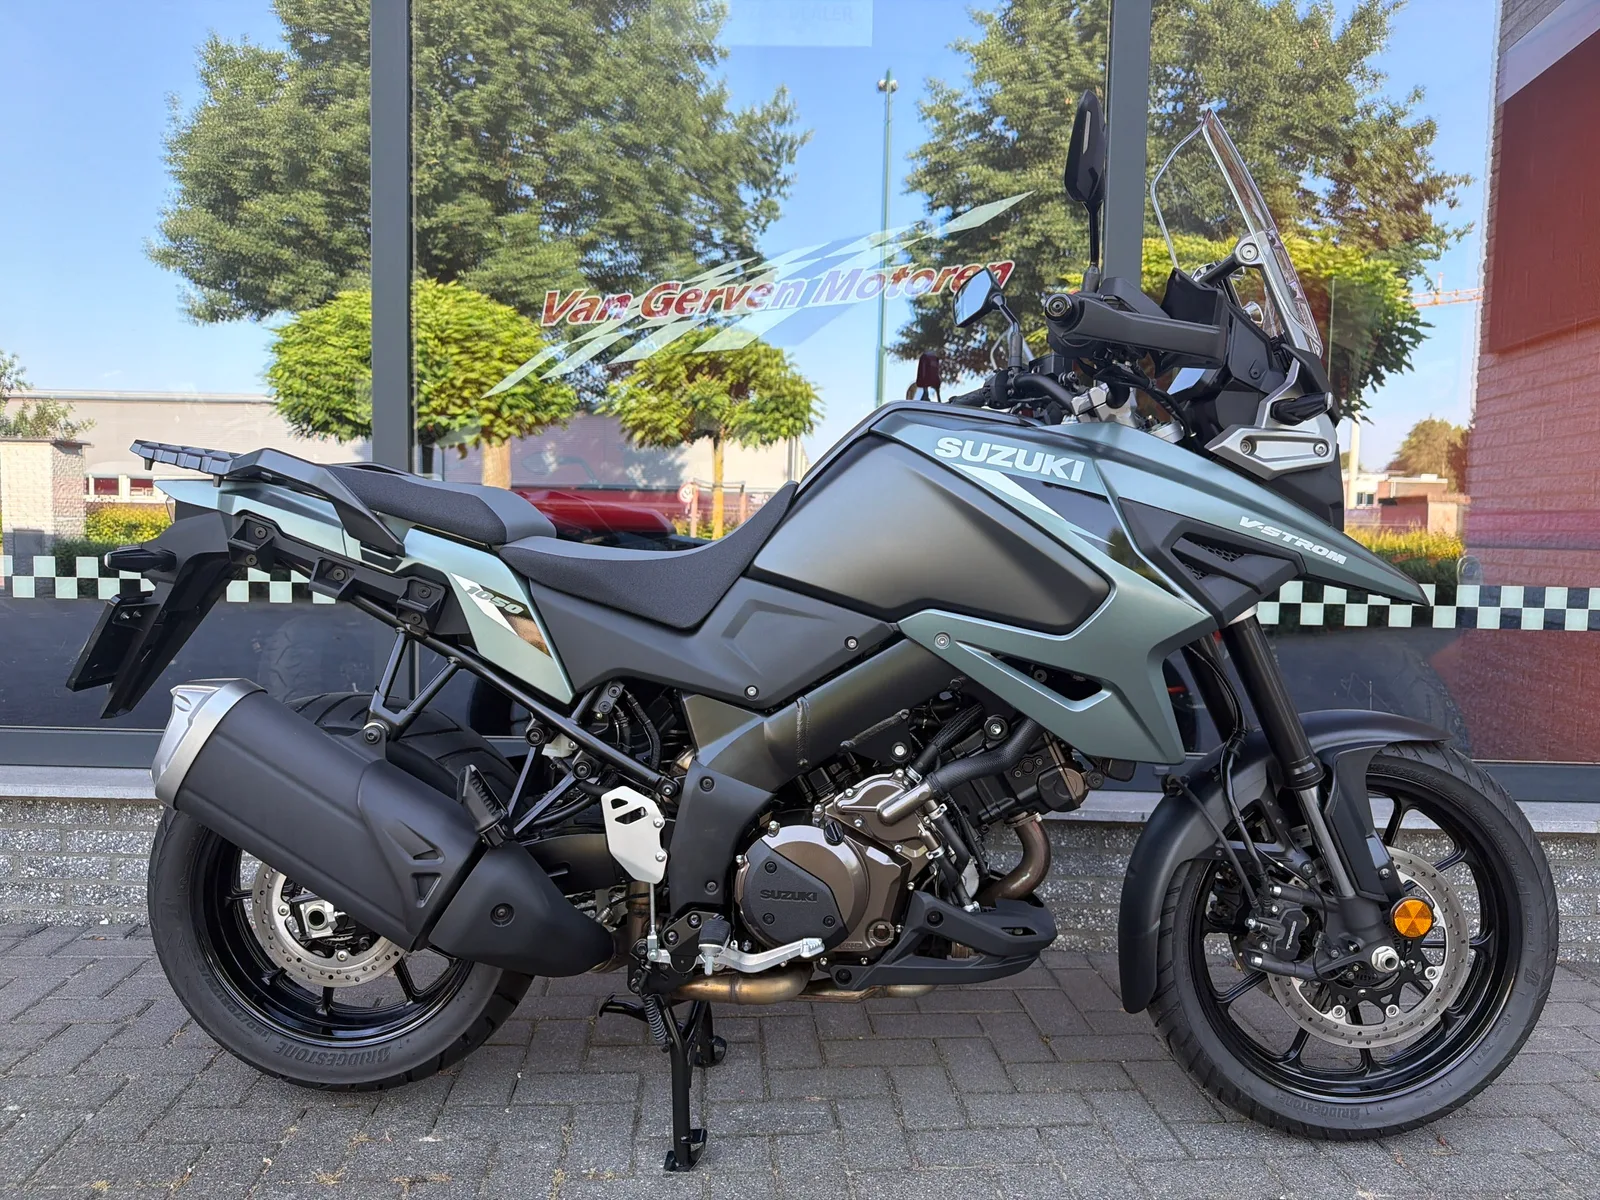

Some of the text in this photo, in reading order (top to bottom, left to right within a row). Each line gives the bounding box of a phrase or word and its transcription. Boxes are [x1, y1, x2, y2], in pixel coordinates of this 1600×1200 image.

[540, 260, 1016, 327] Van Gerven Motoren
[934, 437, 1085, 482] SUZUKI
[1239, 516, 1347, 565] V-STROM
[466, 586, 524, 614] 1050
[760, 889, 818, 903] SUZUKI
[273, 1041, 392, 1067] BRIDGESTONE
[1277, 1093, 1360, 1121] BRIDGESTONE
